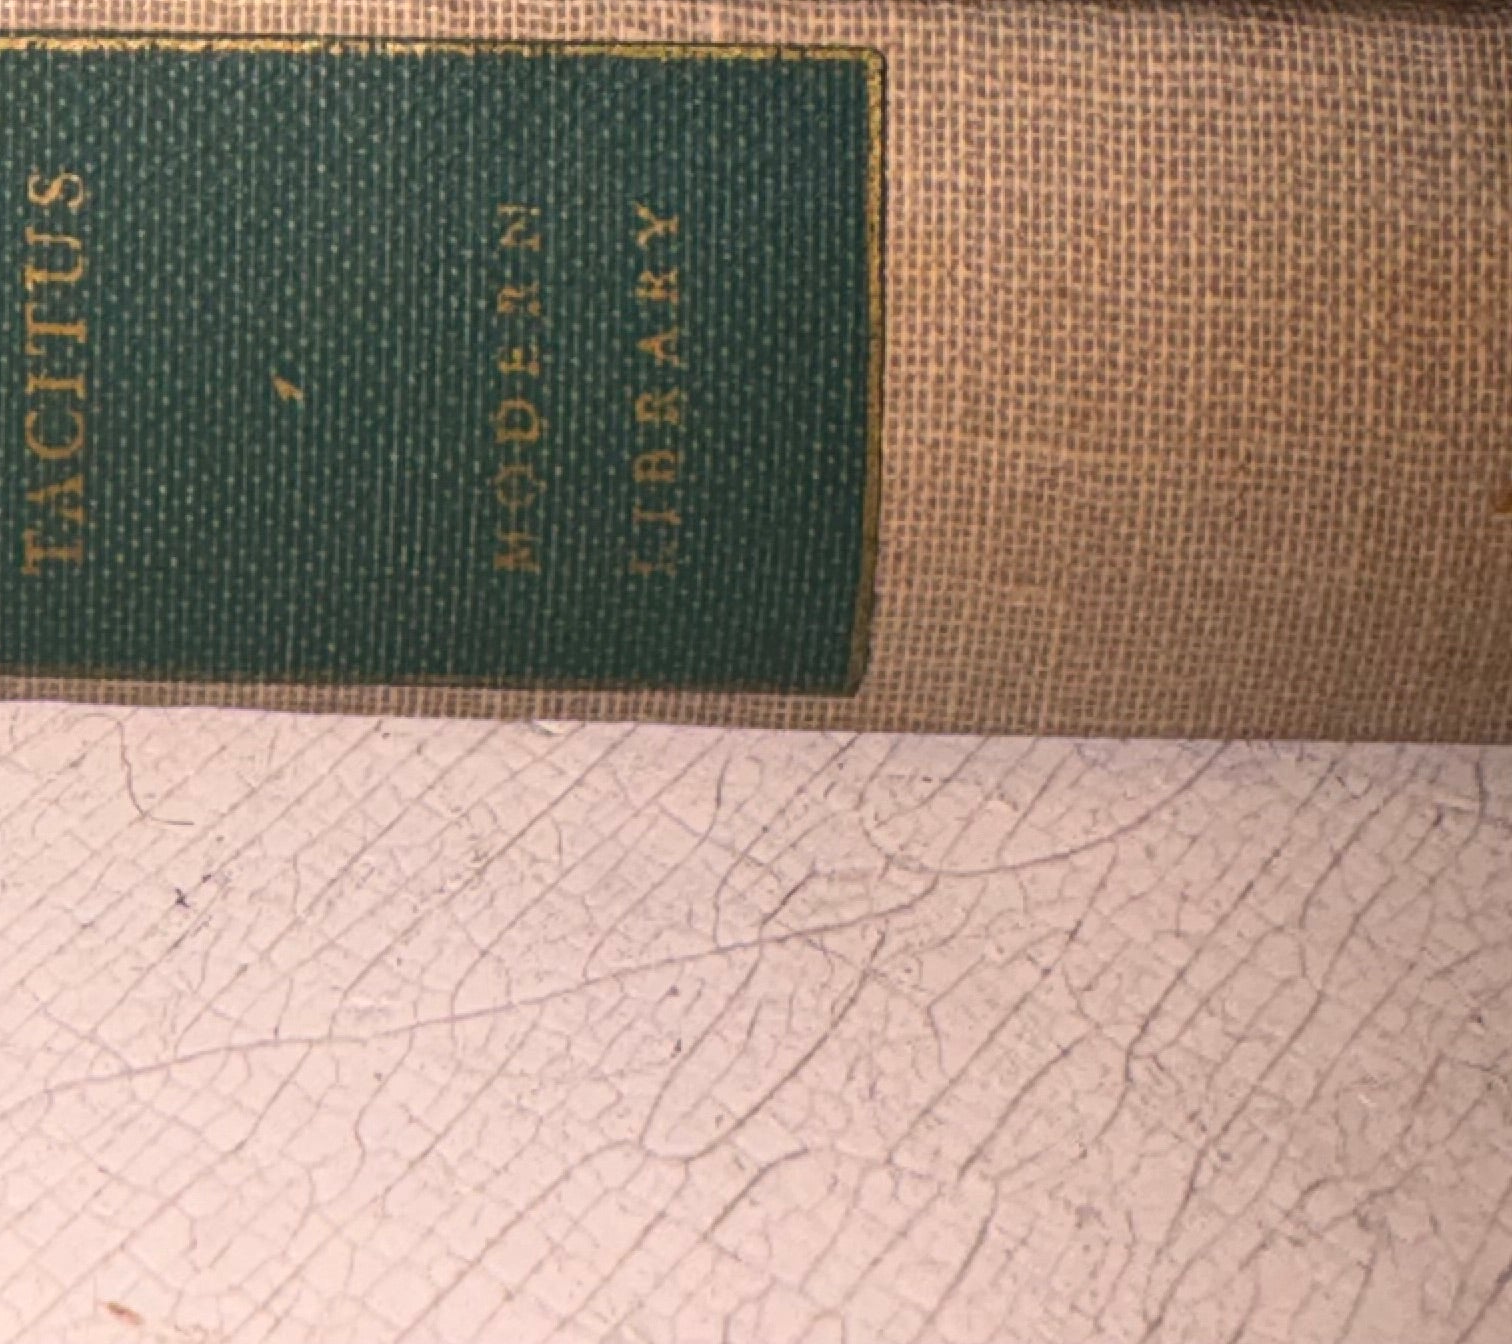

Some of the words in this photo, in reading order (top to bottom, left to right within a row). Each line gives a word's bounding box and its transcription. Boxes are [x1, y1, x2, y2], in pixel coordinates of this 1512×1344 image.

[20, 167, 88, 576] TACITUS
[491, 201, 548, 574] MODERN
[629, 199, 684, 577] LIBRARY
